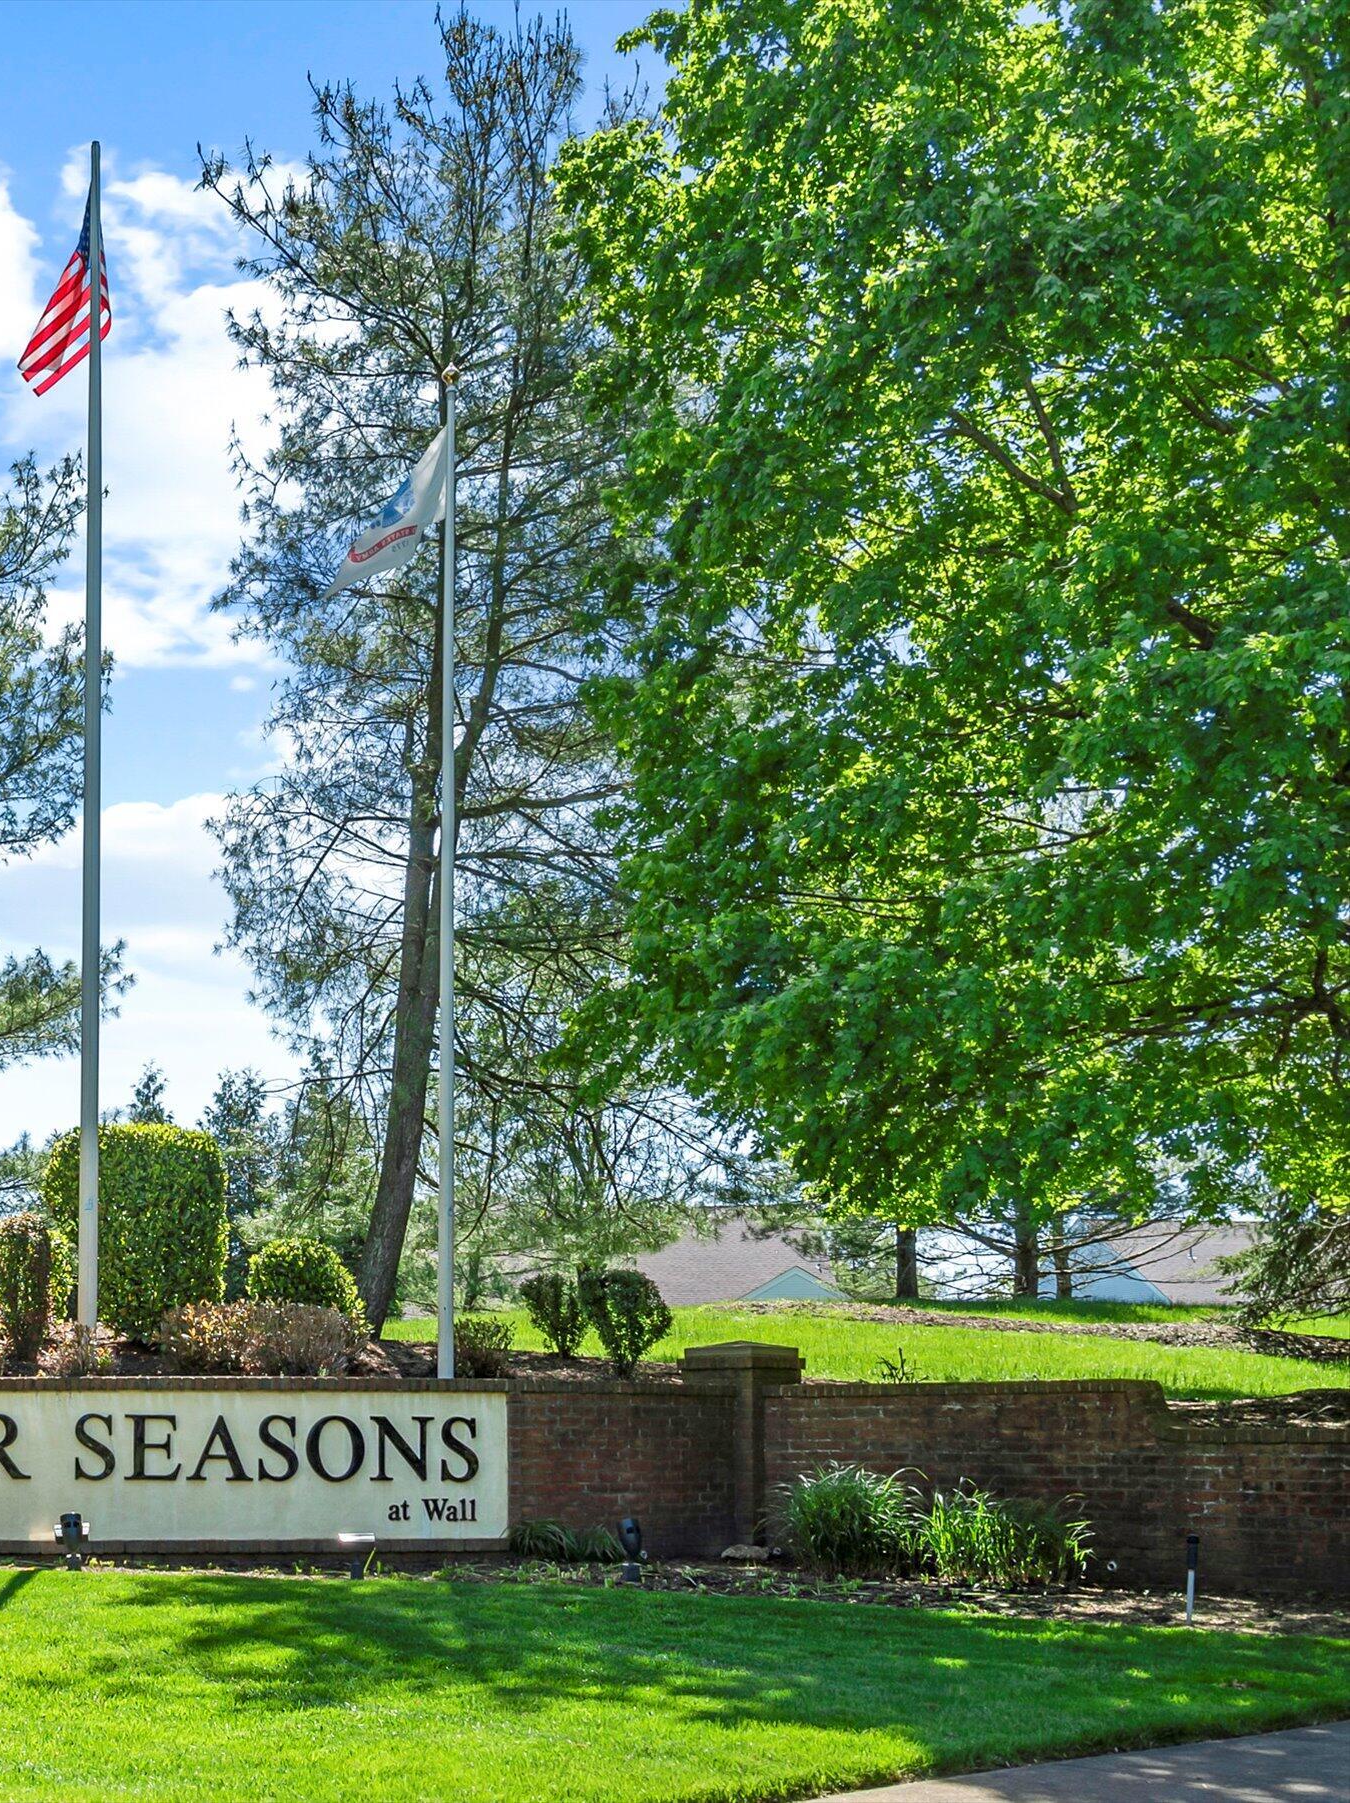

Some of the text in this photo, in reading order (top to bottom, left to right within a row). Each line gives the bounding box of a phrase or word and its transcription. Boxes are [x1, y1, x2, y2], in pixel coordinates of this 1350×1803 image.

[74, 1413, 479, 1483] SEASONS
[388, 1498, 477, 1522] at Wall
